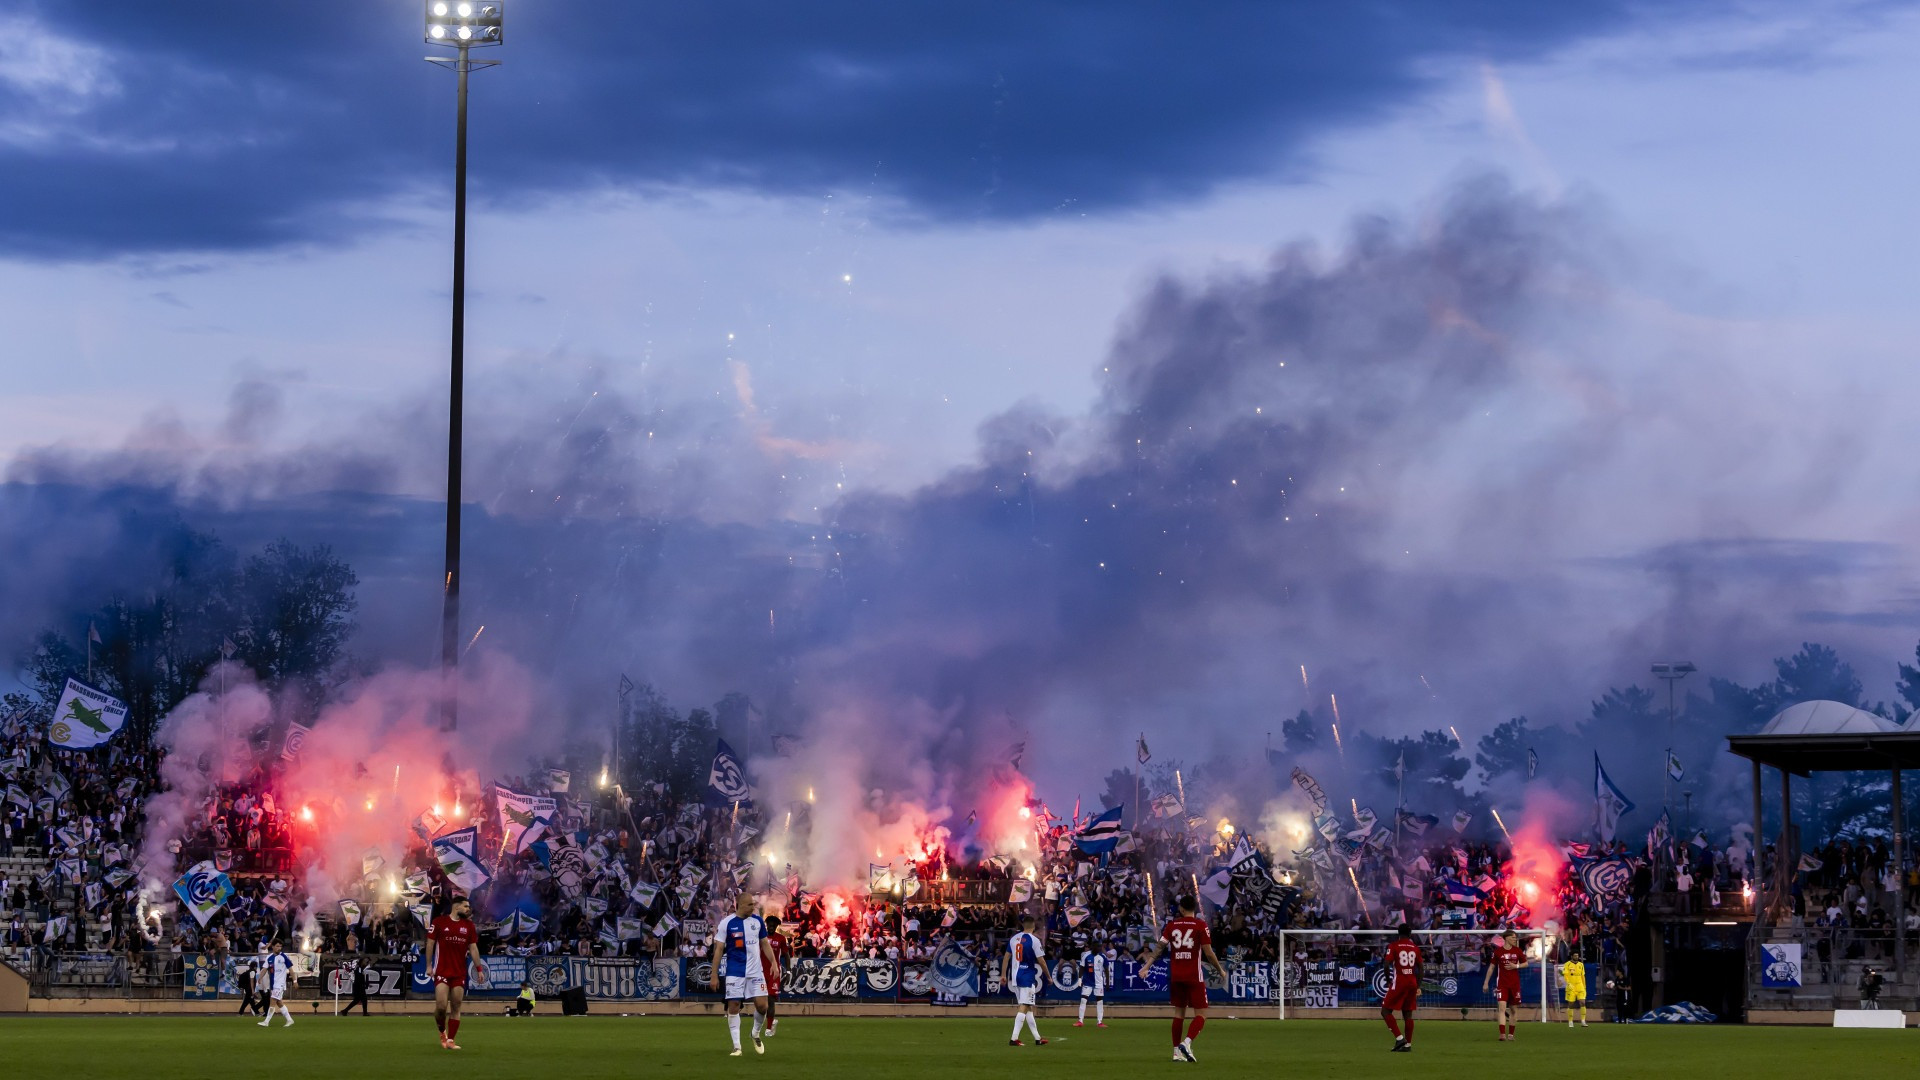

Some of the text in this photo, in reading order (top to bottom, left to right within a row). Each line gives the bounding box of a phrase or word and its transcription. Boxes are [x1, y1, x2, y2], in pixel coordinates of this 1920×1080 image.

[69, 682, 108, 703] GRASSHOPPER
[1171, 928, 1194, 949] 34
[536, 957, 562, 965] SEZIONE
[1016, 944, 1023, 962] 8
[1399, 950, 1416, 967] 88
[573, 961, 635, 997] 1998
[1231, 974, 1250, 985] ULTRA
[1306, 986, 1337, 996] FREE
[1306, 996, 1333, 1007] JUI
